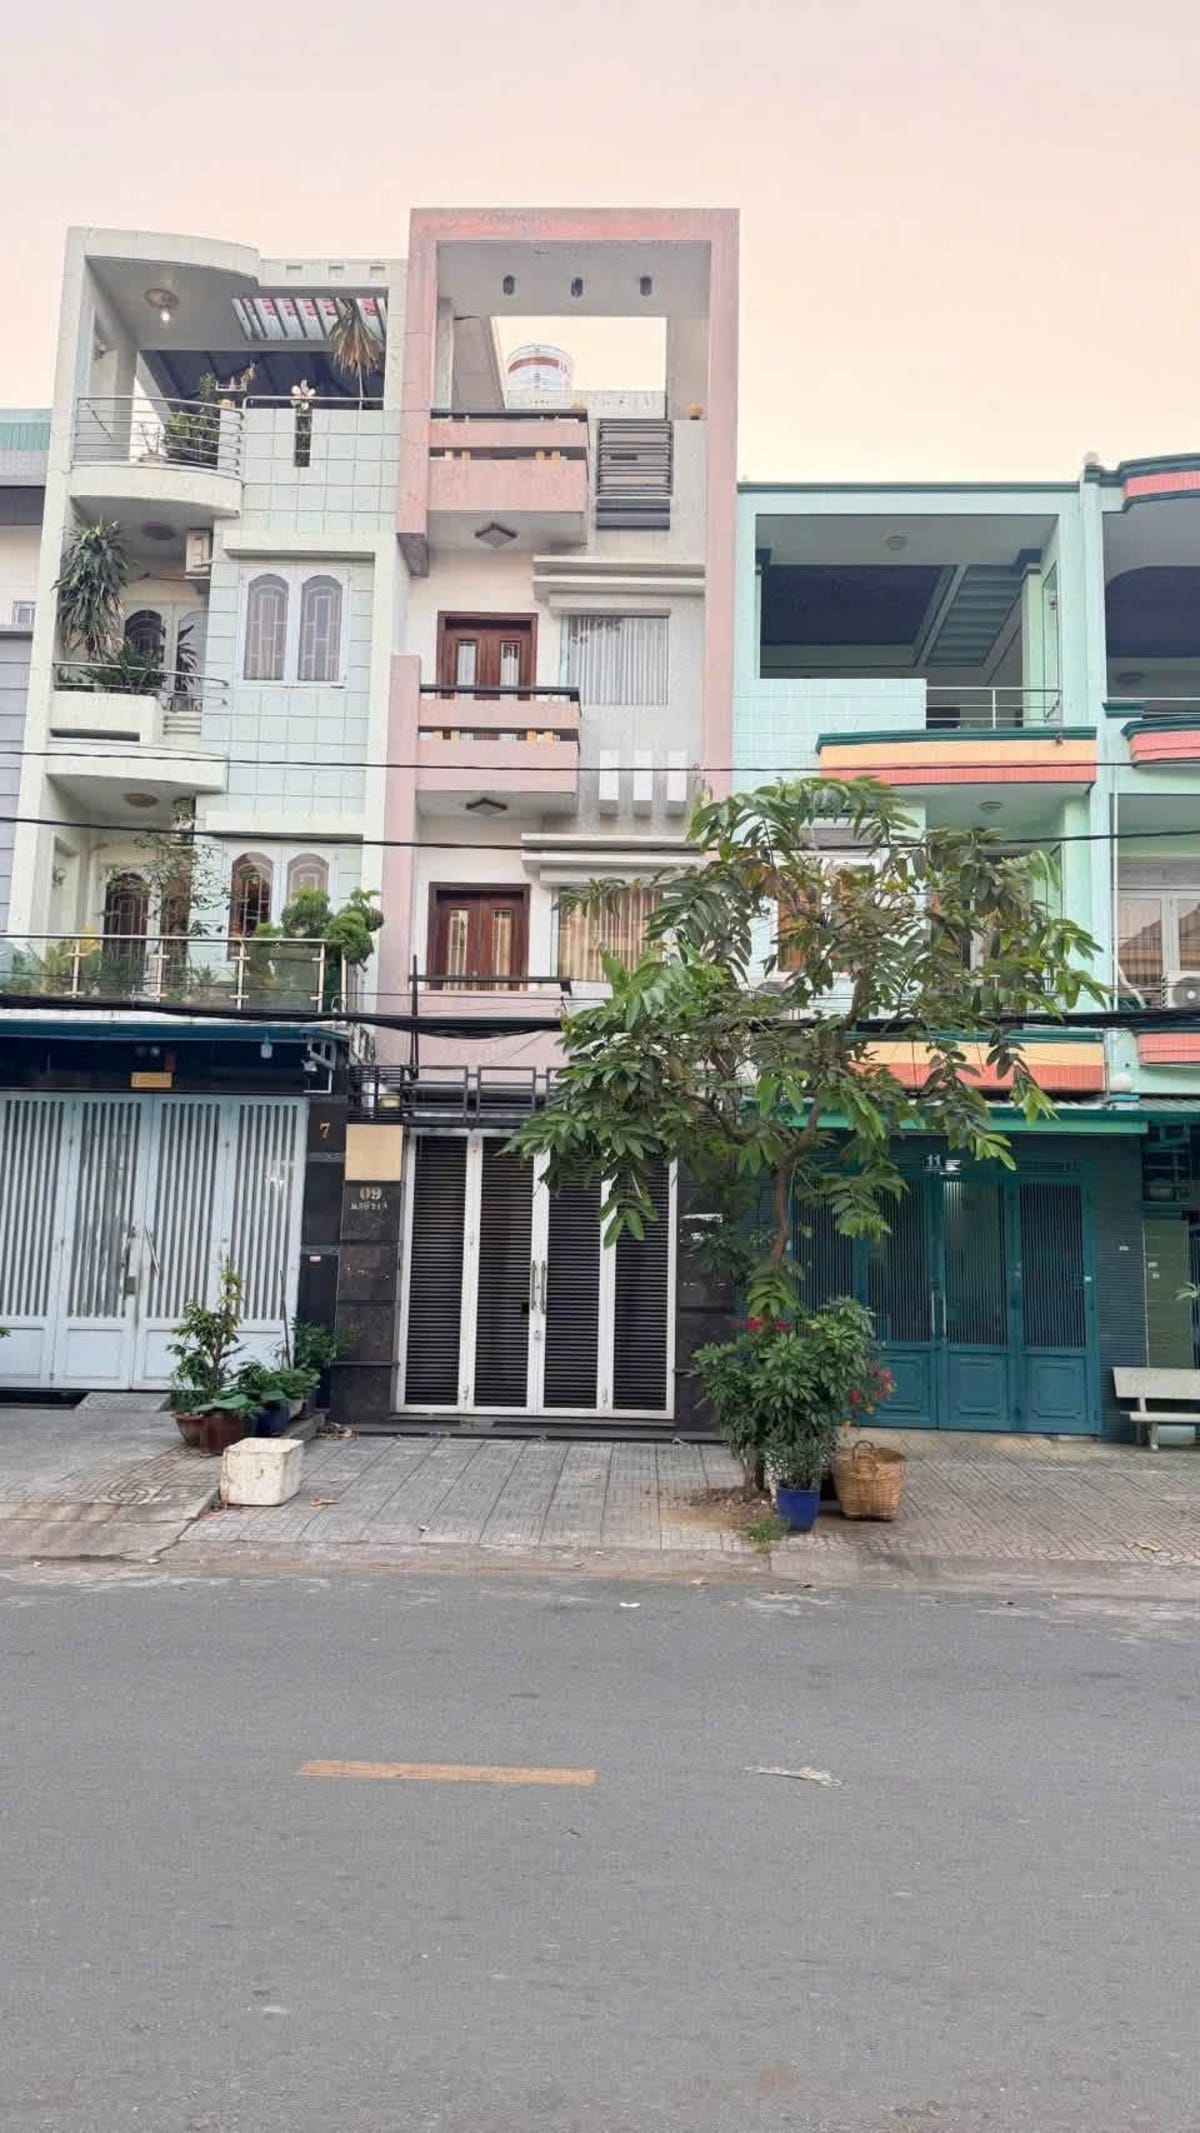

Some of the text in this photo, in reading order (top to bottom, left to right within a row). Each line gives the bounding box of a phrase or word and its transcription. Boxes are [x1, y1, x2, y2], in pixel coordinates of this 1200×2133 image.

[320, 1121, 331, 1139] 7
[926, 1154, 941, 1167] 11
[360, 1186, 382, 1200] 09
